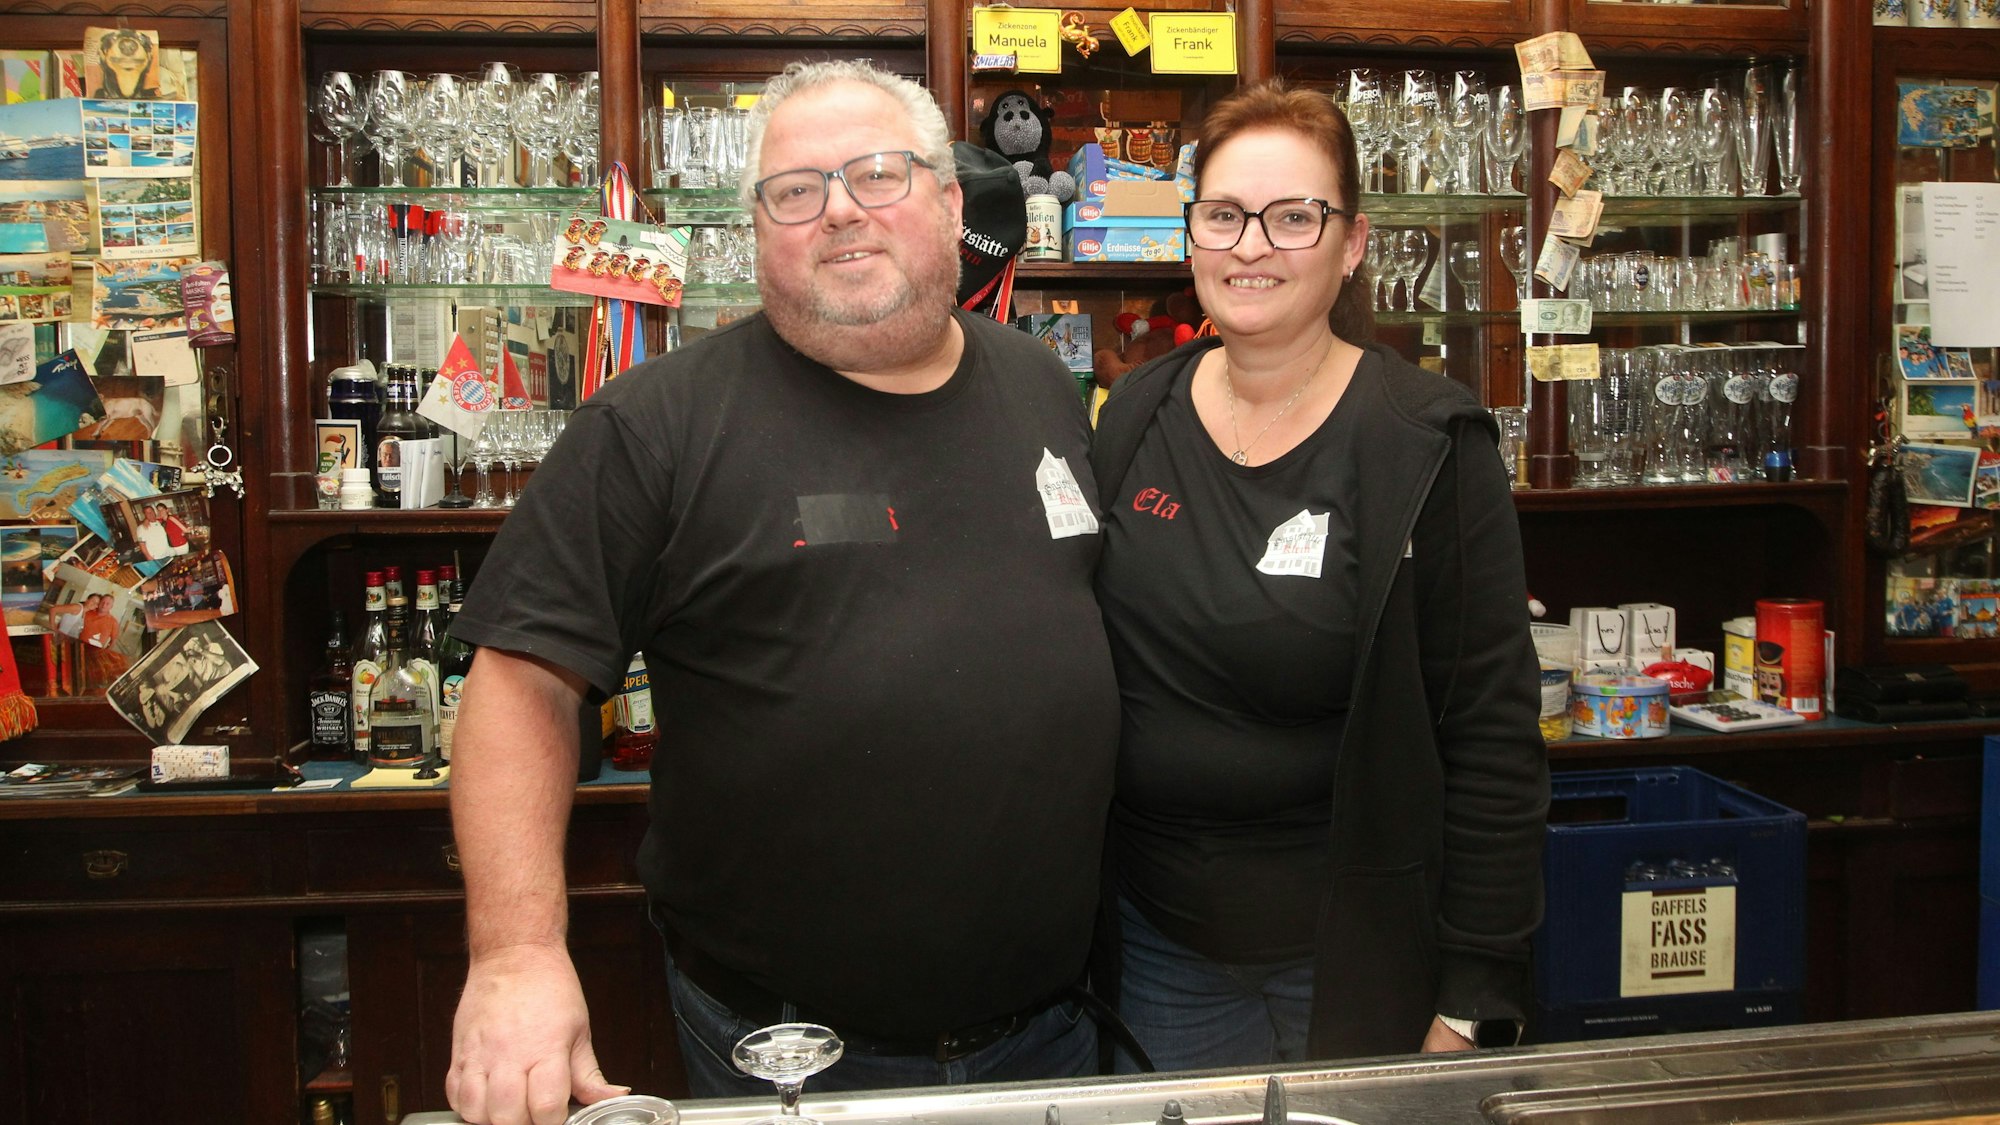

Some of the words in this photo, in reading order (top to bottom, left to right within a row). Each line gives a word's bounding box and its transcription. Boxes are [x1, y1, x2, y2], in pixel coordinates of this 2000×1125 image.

[1122, 21, 1138, 42] Frank
[1166, 26, 1219, 35] Zickenbändiger
[989, 34, 1047, 48] Manuela
[1174, 38, 1213, 50] Frank
[974, 56, 1014, 67] SNICKERS
[1406, 91, 1437, 105] APERO
[1469, 93, 1488, 105] APE
[1093, 183, 1106, 194] ültj
[1082, 209, 1098, 218] ültje
[962, 226, 1009, 258] tstätte
[1106, 243, 1140, 252] Erdnüsse
[1082, 244, 1099, 253] ültje
[1154, 248, 1161, 257] go
[1132, 487, 1182, 520] Ela
[1283, 544, 1311, 554] Klein
[624, 674, 650, 689] APER
[1725, 671, 1752, 684] auchen
[311, 695, 325, 707] JACK
[1652, 898, 1706, 916] GAFFELS
[1651, 918, 1707, 947] FASS
[1651, 950, 1706, 969] BRAUSE
